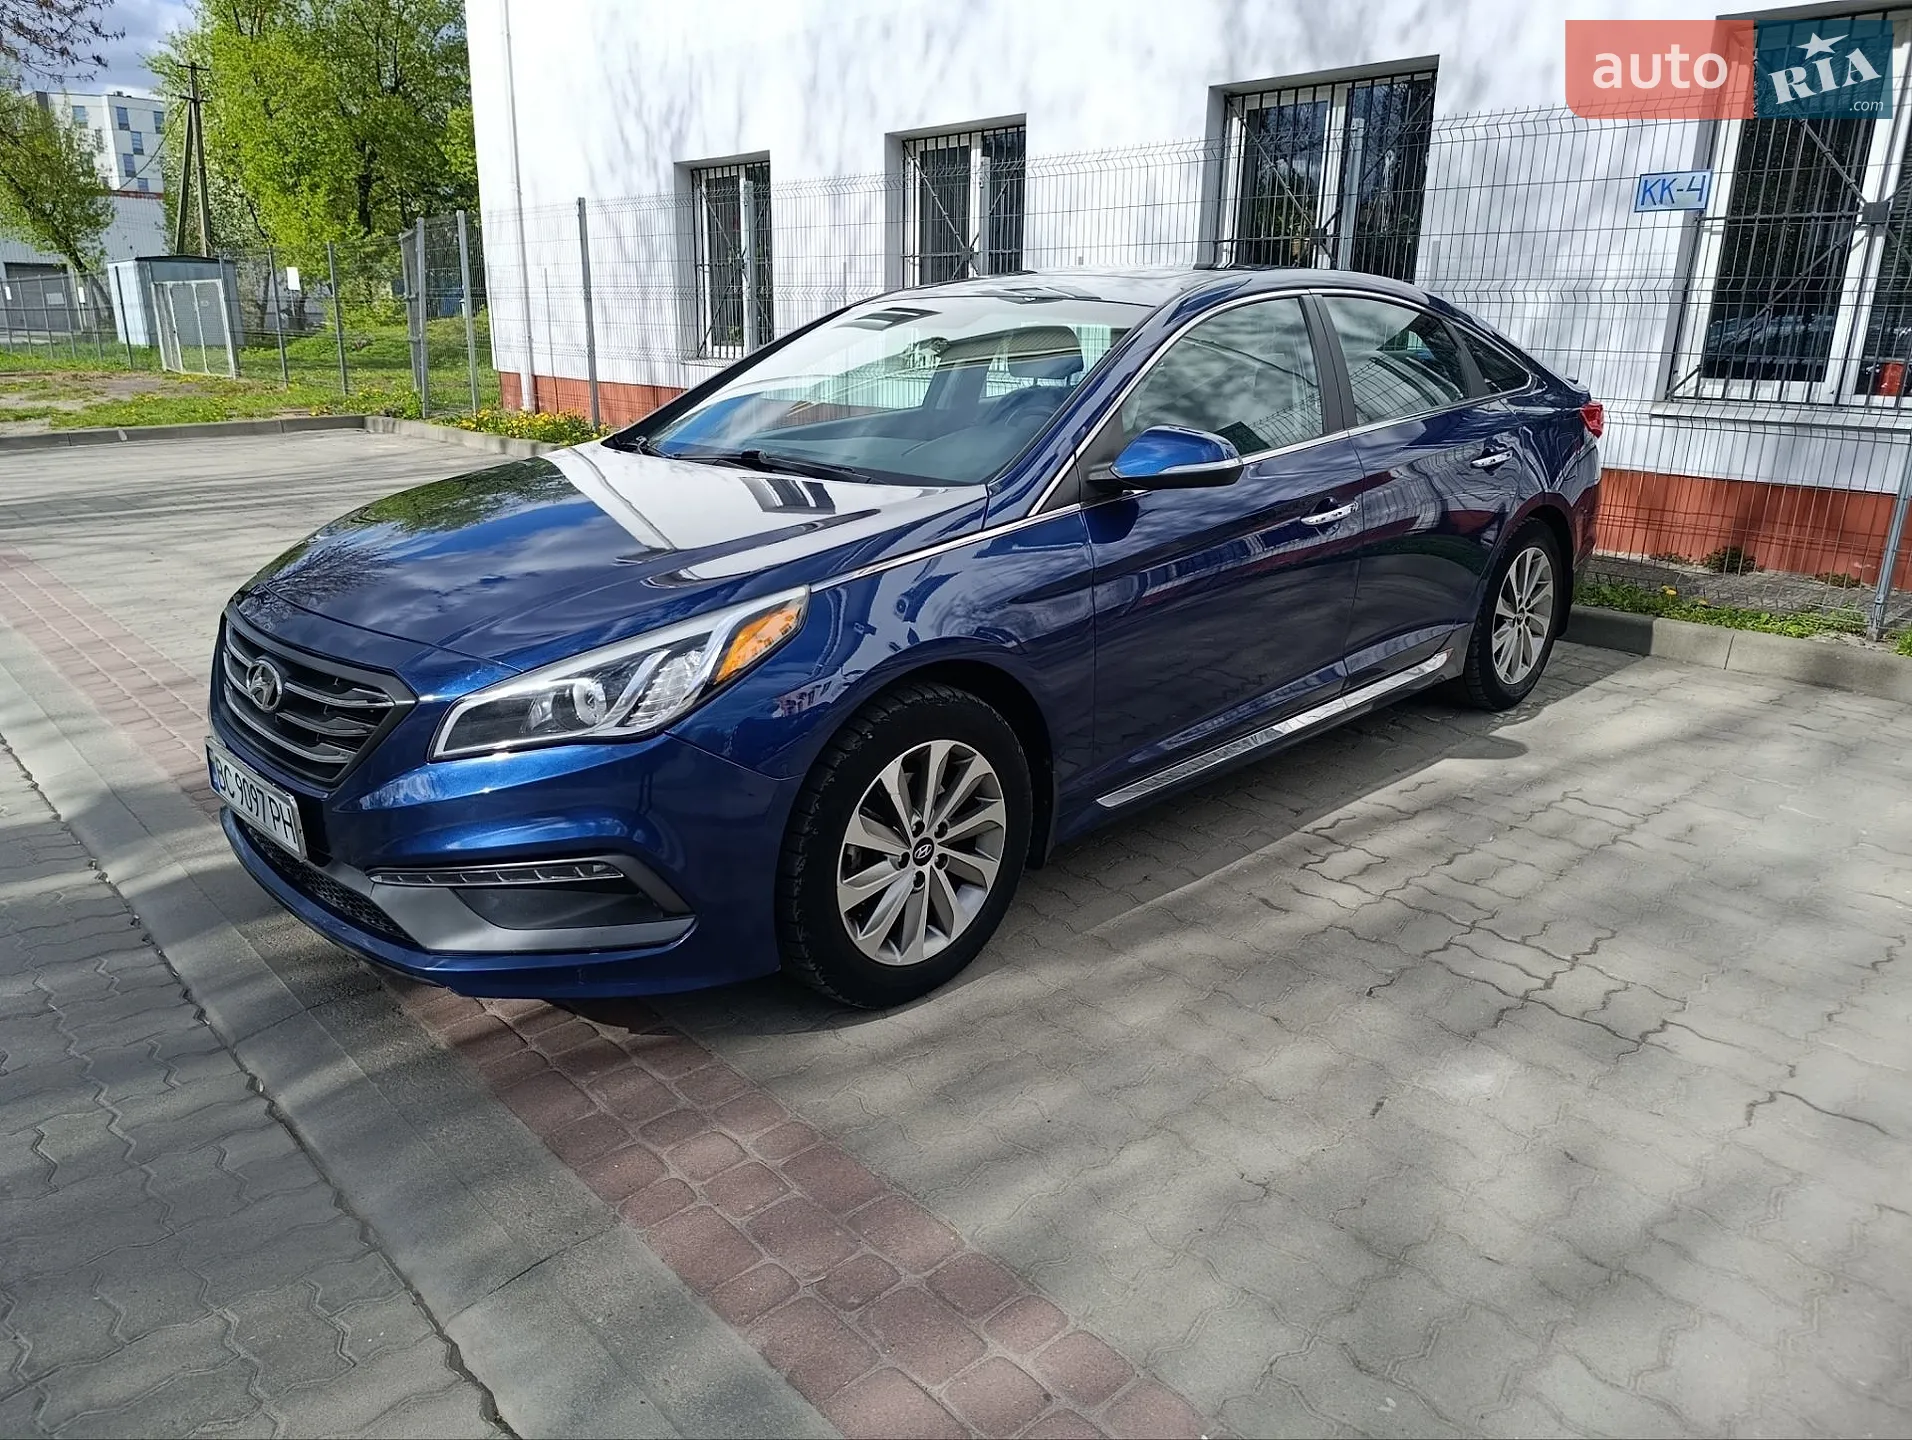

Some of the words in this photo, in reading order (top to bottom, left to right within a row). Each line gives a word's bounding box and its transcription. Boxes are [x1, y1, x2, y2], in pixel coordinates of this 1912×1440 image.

[215, 756, 234, 799] BC
[235, 772, 266, 823] 9097
[268, 795, 297, 844] PH
